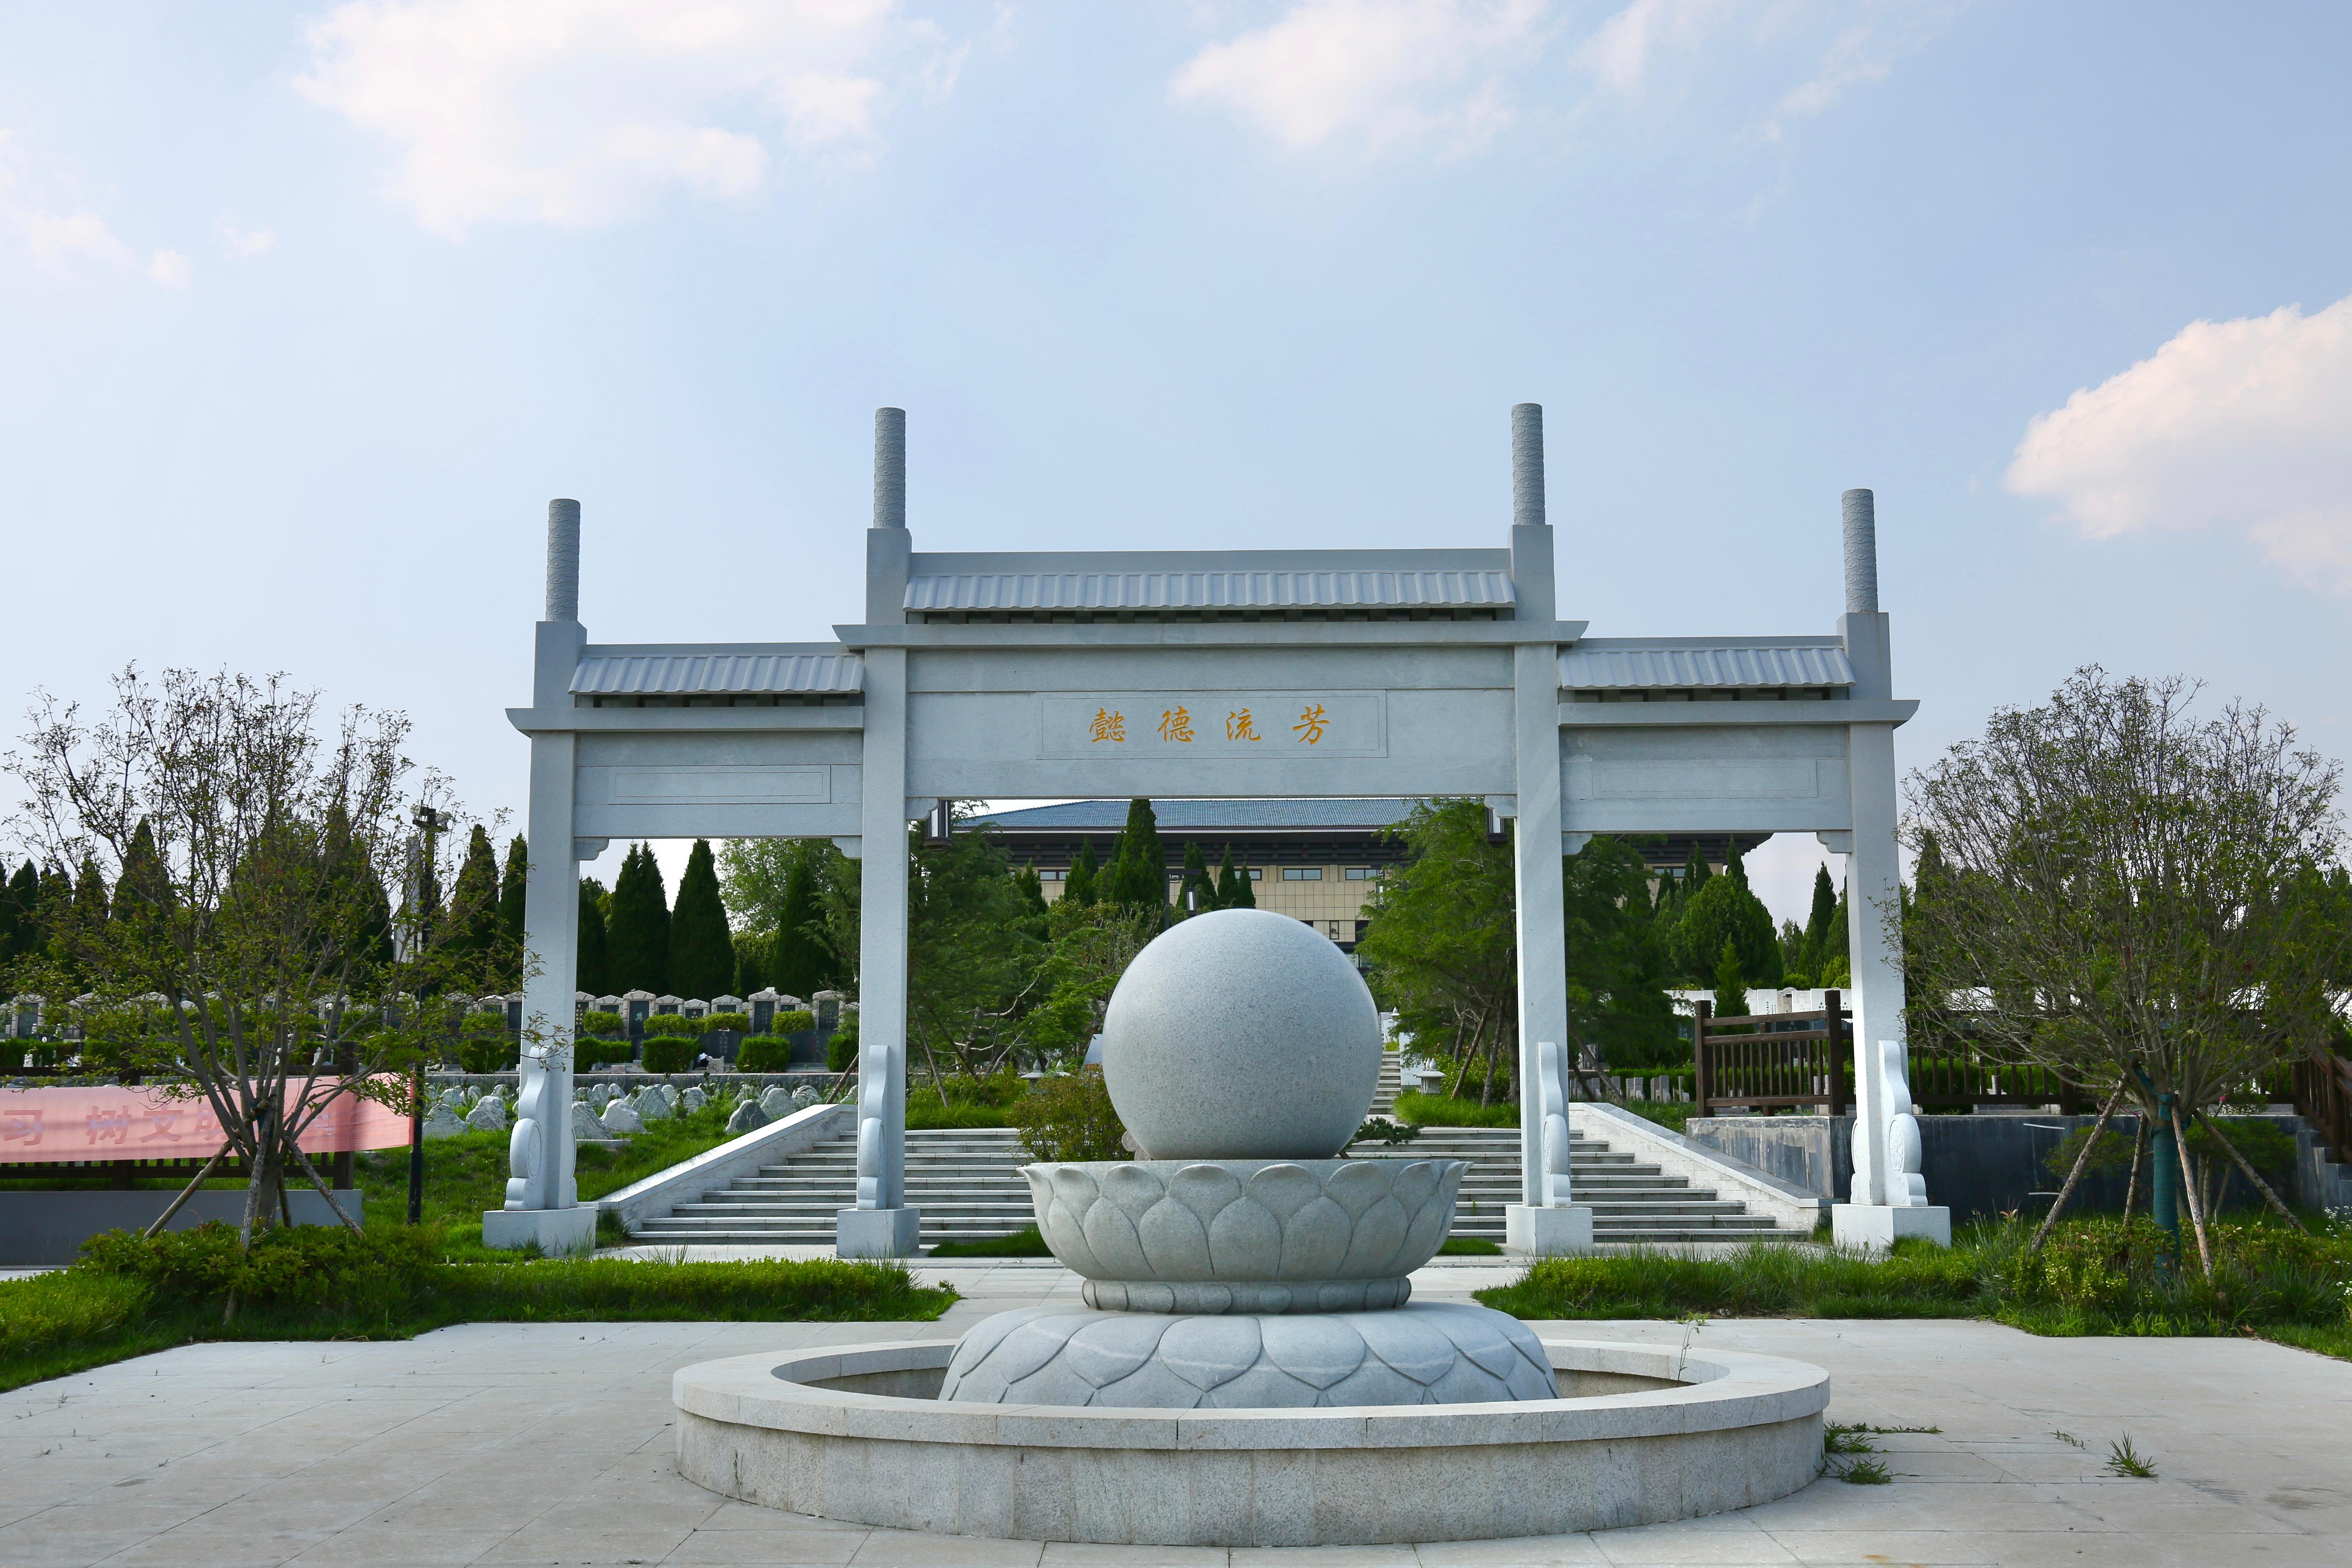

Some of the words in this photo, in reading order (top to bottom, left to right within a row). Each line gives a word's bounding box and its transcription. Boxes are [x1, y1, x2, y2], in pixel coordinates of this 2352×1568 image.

[1089, 704, 1330, 746] 懿德流芳
[3, 1109, 43, 1146] 习
